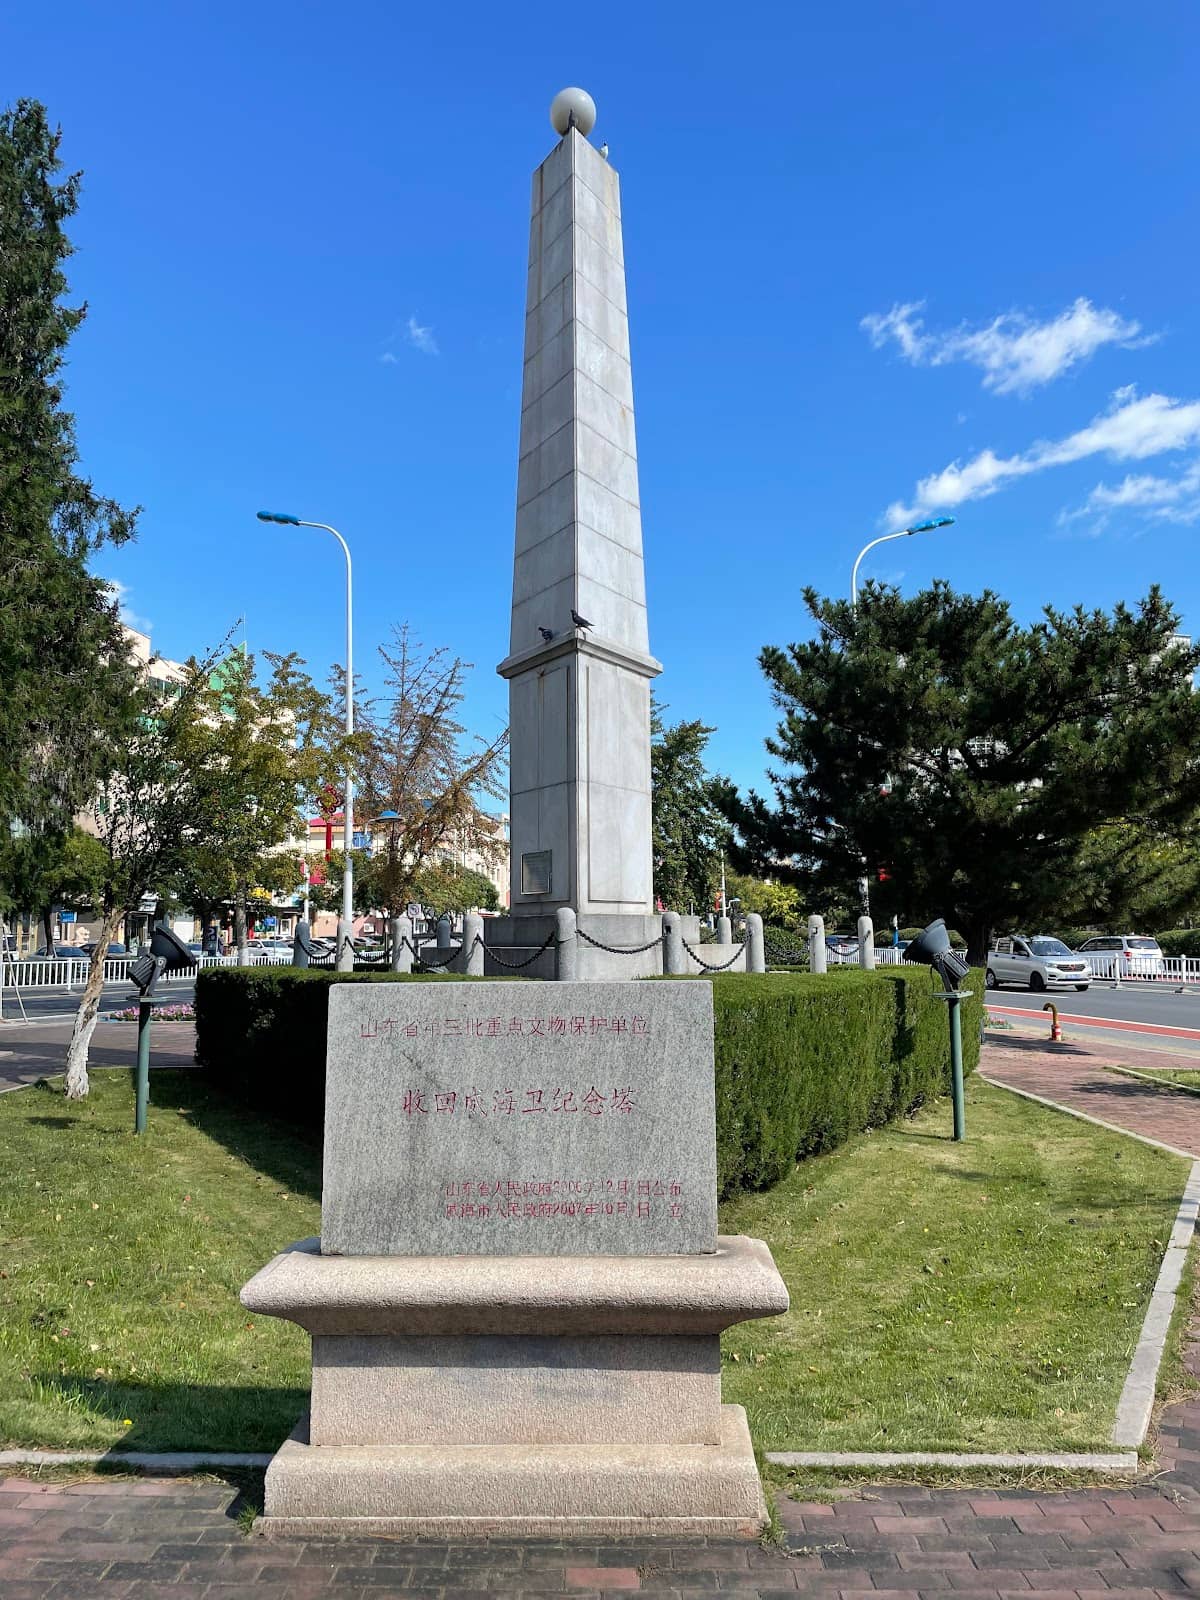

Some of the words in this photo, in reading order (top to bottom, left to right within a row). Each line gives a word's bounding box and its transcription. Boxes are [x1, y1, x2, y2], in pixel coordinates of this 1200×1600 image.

[402, 1086, 637, 1117] 收回威海卫纪念塔
